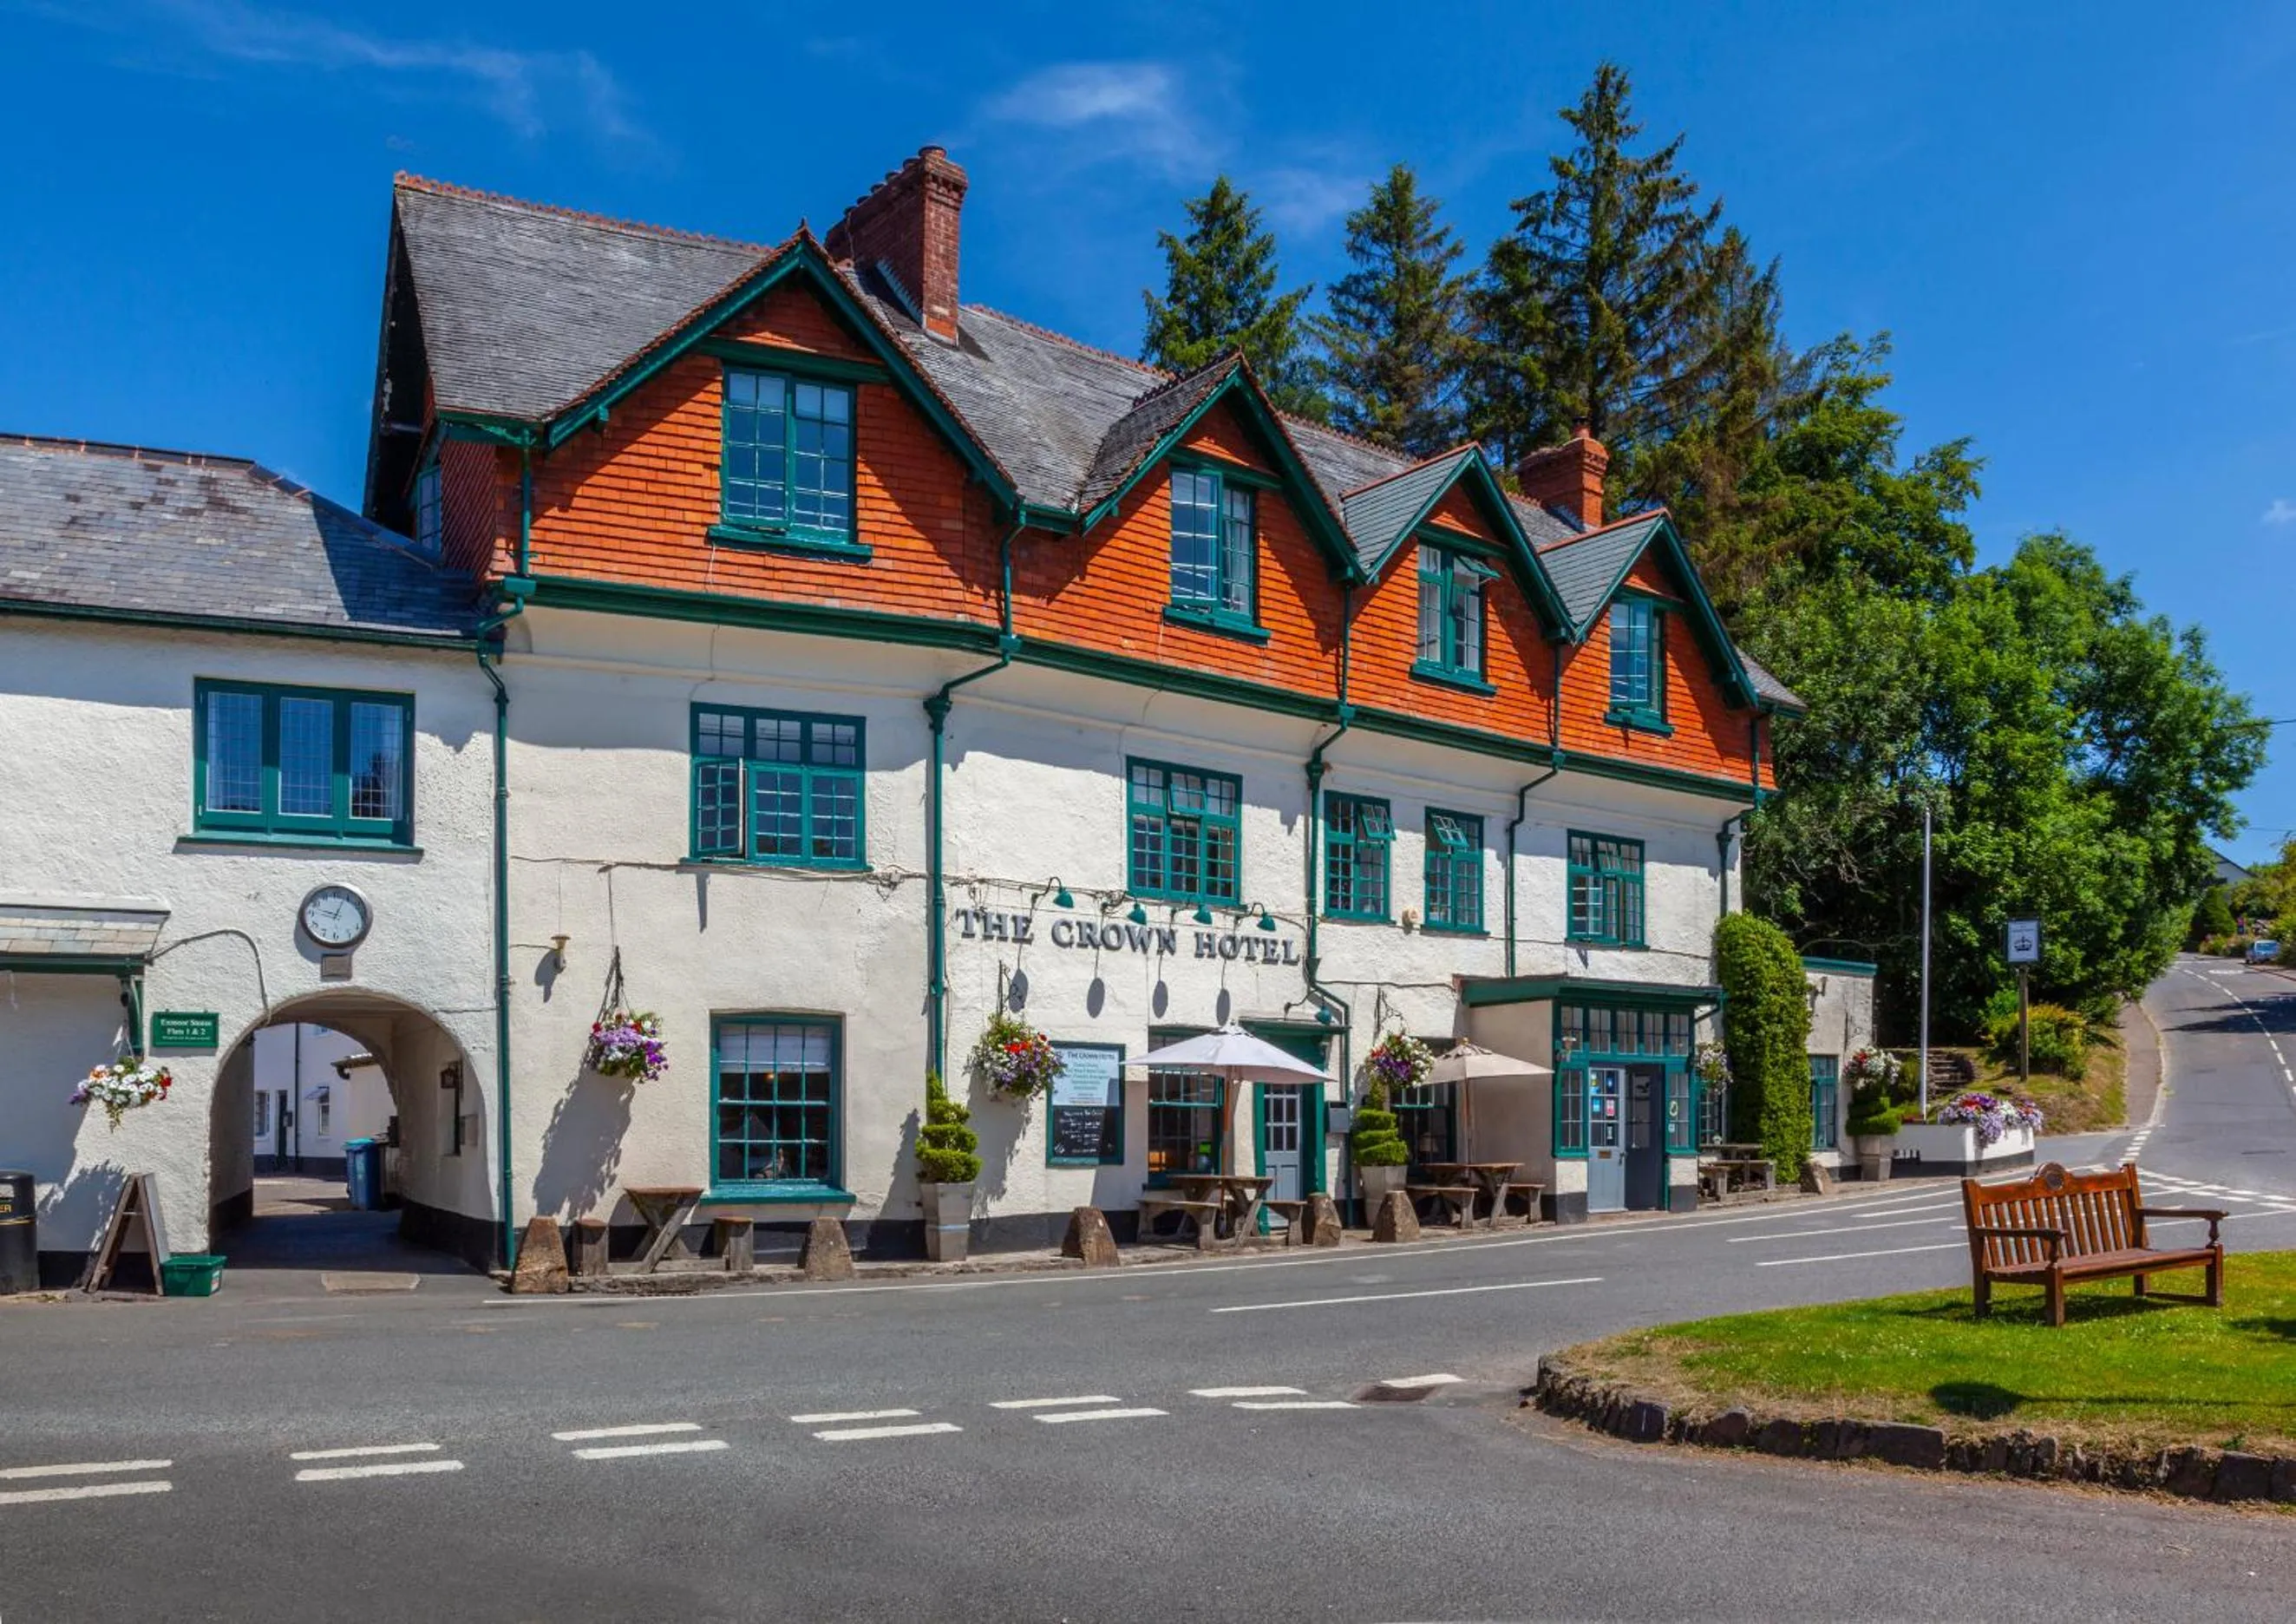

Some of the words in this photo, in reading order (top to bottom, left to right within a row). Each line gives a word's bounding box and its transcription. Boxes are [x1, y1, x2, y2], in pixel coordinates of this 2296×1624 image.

[956, 908, 1034, 945] THE
[1051, 918, 1178, 955] CROWN
[1194, 931, 1300, 966] HOTEL
